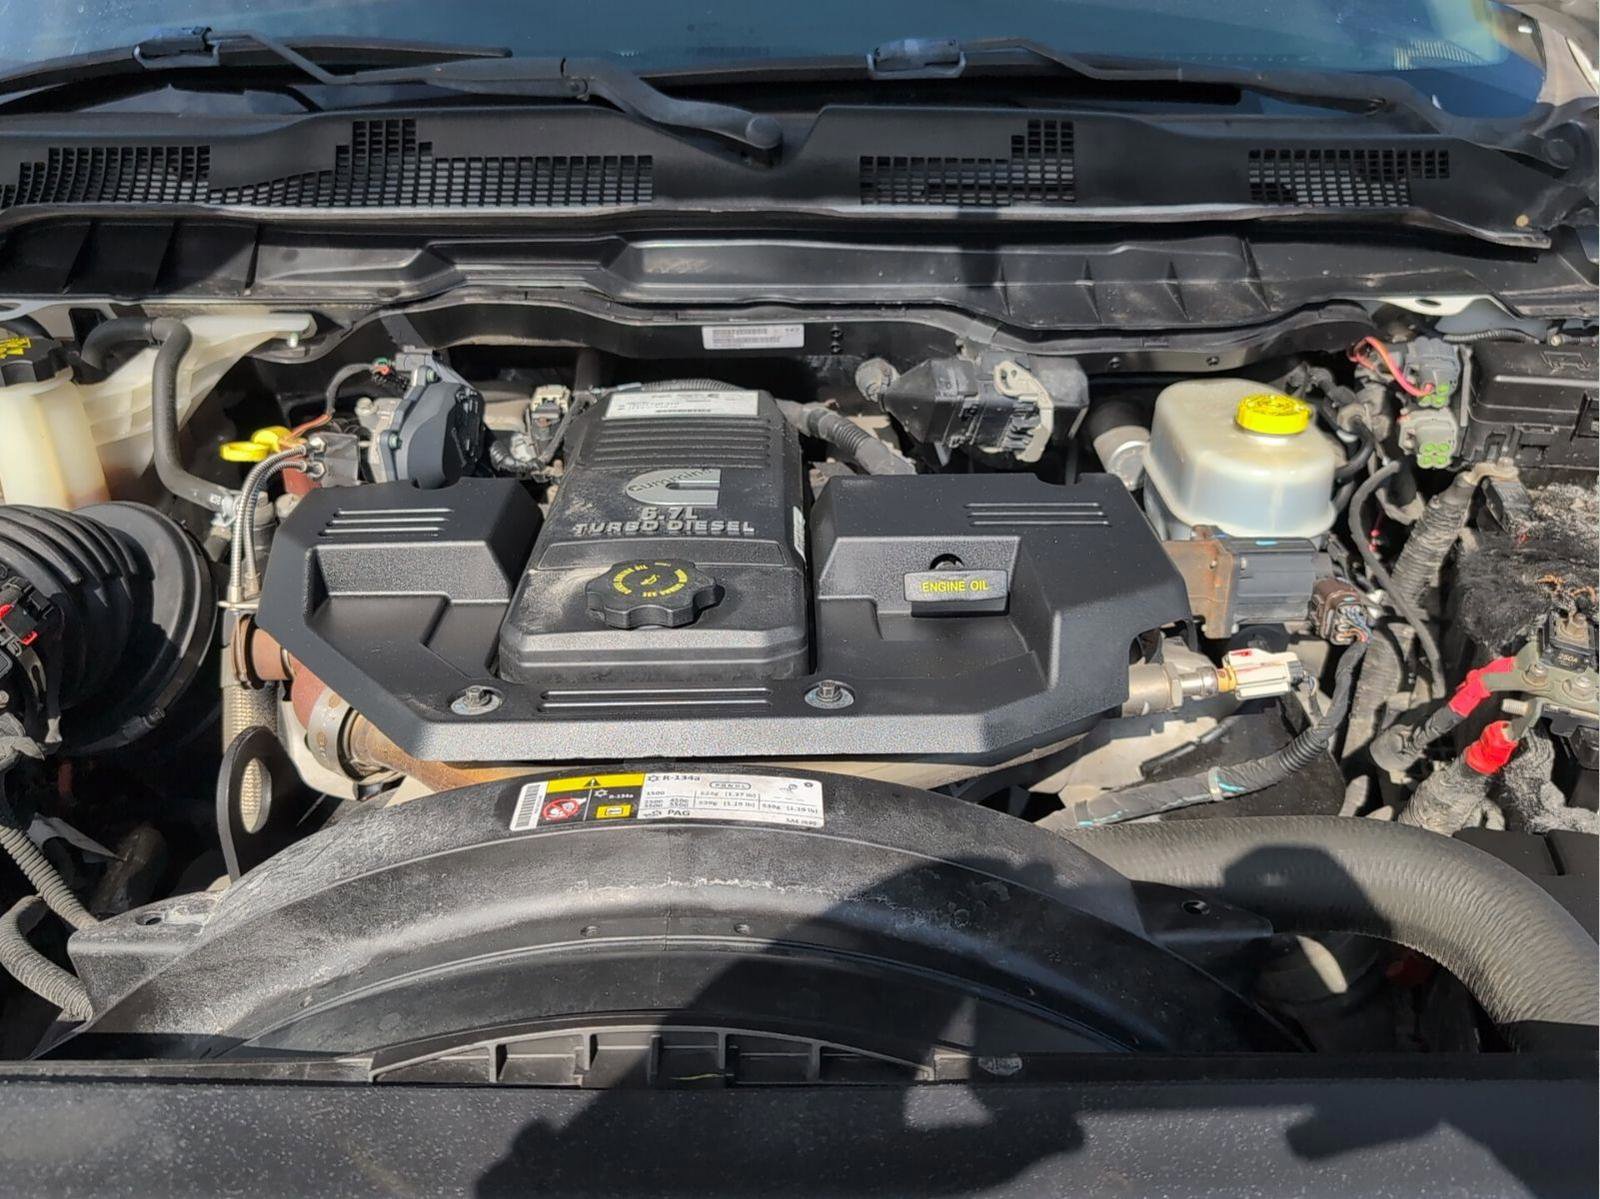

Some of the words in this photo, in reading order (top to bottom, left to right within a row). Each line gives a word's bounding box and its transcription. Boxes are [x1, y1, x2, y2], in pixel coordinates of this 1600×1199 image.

[640, 506, 698, 521] 6.7L
[574, 520, 659, 535] TURBO
[667, 520, 755, 534] DIESEL
[922, 580, 966, 592] ENGINE
[970, 579, 989, 590] OIL
